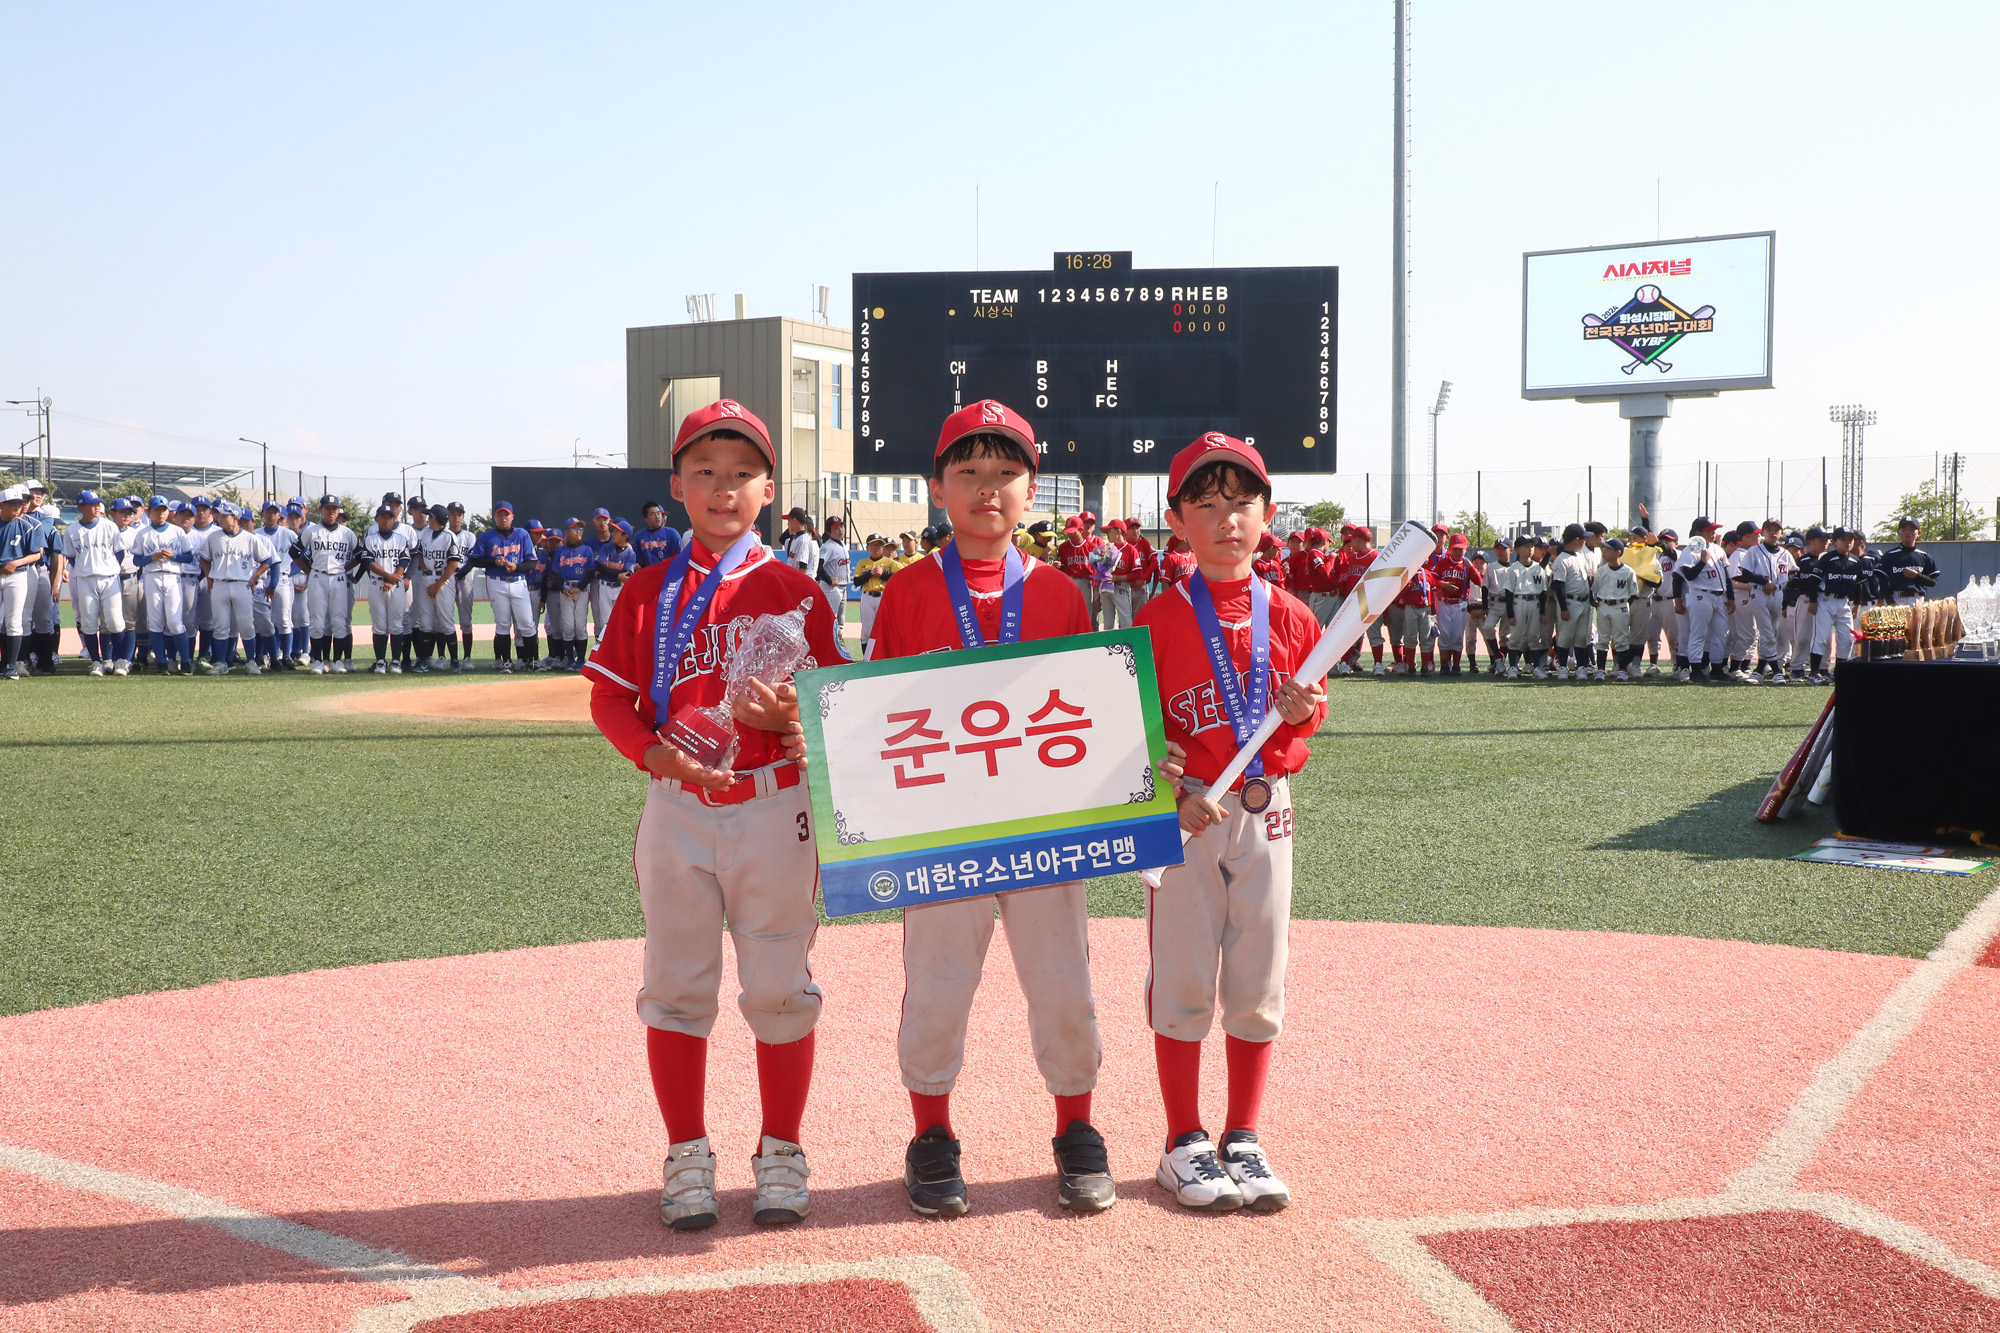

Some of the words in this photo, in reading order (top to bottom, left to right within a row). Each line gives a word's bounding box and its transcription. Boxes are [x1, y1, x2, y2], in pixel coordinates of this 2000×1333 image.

[1065, 253, 1112, 270] 16:28
[1602, 257, 1692, 279] 시사저널
[969, 289, 1019, 304] TEAM
[1038, 289, 1044, 303] 1
[1051, 289, 1061, 303] 2
[1066, 289, 1076, 303] 3
[1080, 288, 1091, 302] 4
[1095, 288, 1105, 302] 5
[1110, 288, 1120, 302] 6
[1125, 288, 1135, 302] 7
[1140, 288, 1150, 302] 8
[1154, 287, 1164, 302] 9
[861, 307, 870, 321] 1
[973, 305, 1014, 319] 시상식
[1320, 302, 1330, 315] 1
[1601, 305, 1619, 320] 2024
[1320, 317, 1330, 330] 2
[1619, 311, 1676, 324] 화성시장배
[861, 322, 870, 335] 2
[1584, 319, 1712, 339] 전국유소년야구대회
[861, 337, 870, 350] 3
[1320, 332, 1330, 345] 3
[1631, 336, 1667, 348] KYBF
[861, 352, 870, 365] 4
[1320, 347, 1330, 360] 4
[861, 366, 870, 379] 5
[950, 360, 967, 375] CH
[1036, 360, 1048, 374] B
[1106, 360, 1118, 374] H
[1320, 362, 1330, 375] 5
[861, 381, 870, 394] 6
[1036, 377, 1048, 391] S
[1106, 377, 1118, 390] E
[1320, 377, 1330, 390] 6
[861, 395, 870, 409] 7
[1096, 394, 1118, 408] FC
[1320, 392, 1330, 405] 7
[861, 410, 870, 423] 8
[1320, 407, 1330, 420] 8
[861, 425, 870, 438] 9
[1320, 422, 1330, 435] 9
[875, 438, 885, 452] P
[1132, 439, 1155, 454] SP
[314, 541, 348, 551] DAECHI
[1380, 526, 1411, 563] TITANX
[1532, 575, 1542, 585] W
[1706, 570, 1717, 579] 10
[1616, 579, 1627, 589] W
[659, 581, 677, 634] 전국유소년야구대회
[959, 605, 978, 647] 유소년야구대회
[657, 636, 667, 669] 화성시장배
[1210, 636, 1235, 691] 전국유소년야구대회
[656, 671, 664, 688] 2024
[1227, 692, 1244, 724] 화성시장배
[880, 688, 1093, 790] 준우승
[1240, 725, 1250, 742] 2024
[796, 812, 809, 841] 3
[1264, 807, 1292, 842] 22
[905, 835, 1138, 895] 대한유소년야구연맹
